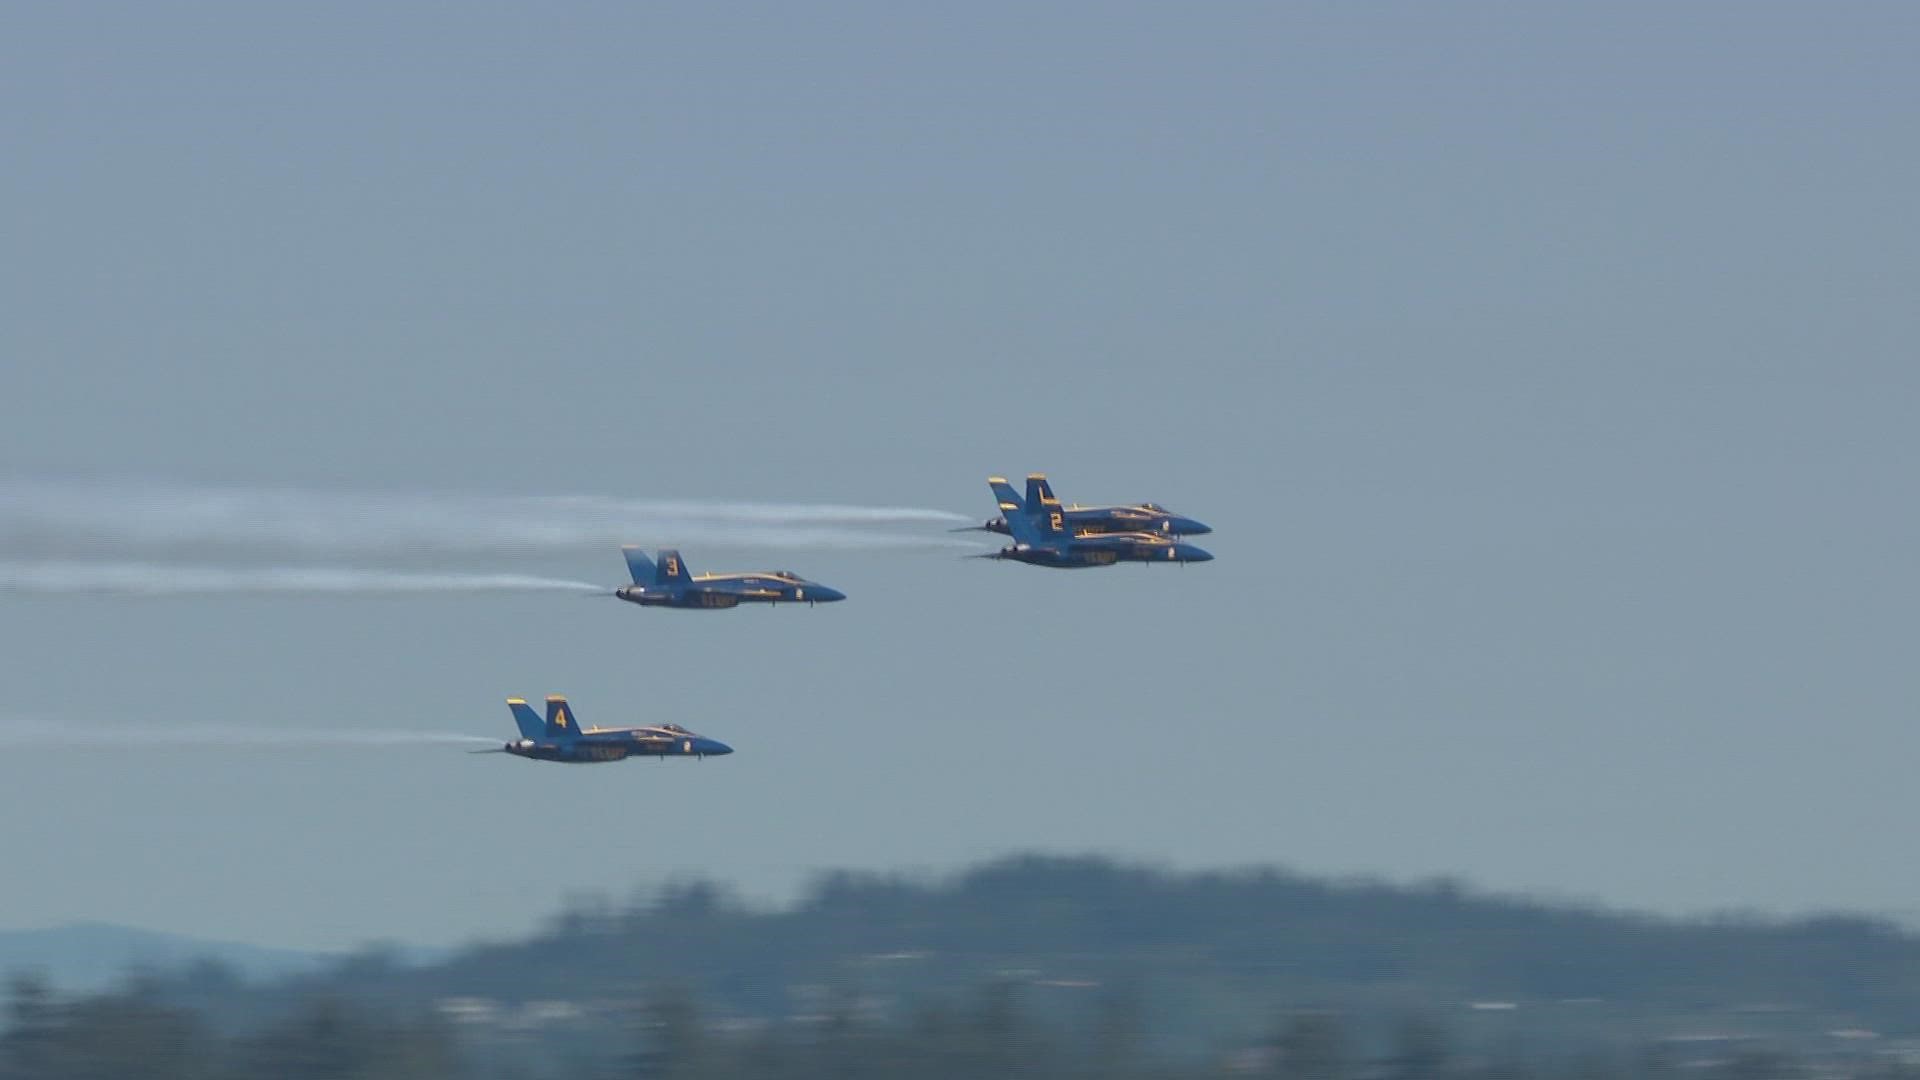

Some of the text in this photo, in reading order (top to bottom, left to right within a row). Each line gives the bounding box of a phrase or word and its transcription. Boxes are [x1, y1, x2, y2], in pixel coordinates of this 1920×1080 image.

[1050, 512, 1064, 531] 2
[666, 557, 679, 577] 3
[555, 707, 568, 729] 4
